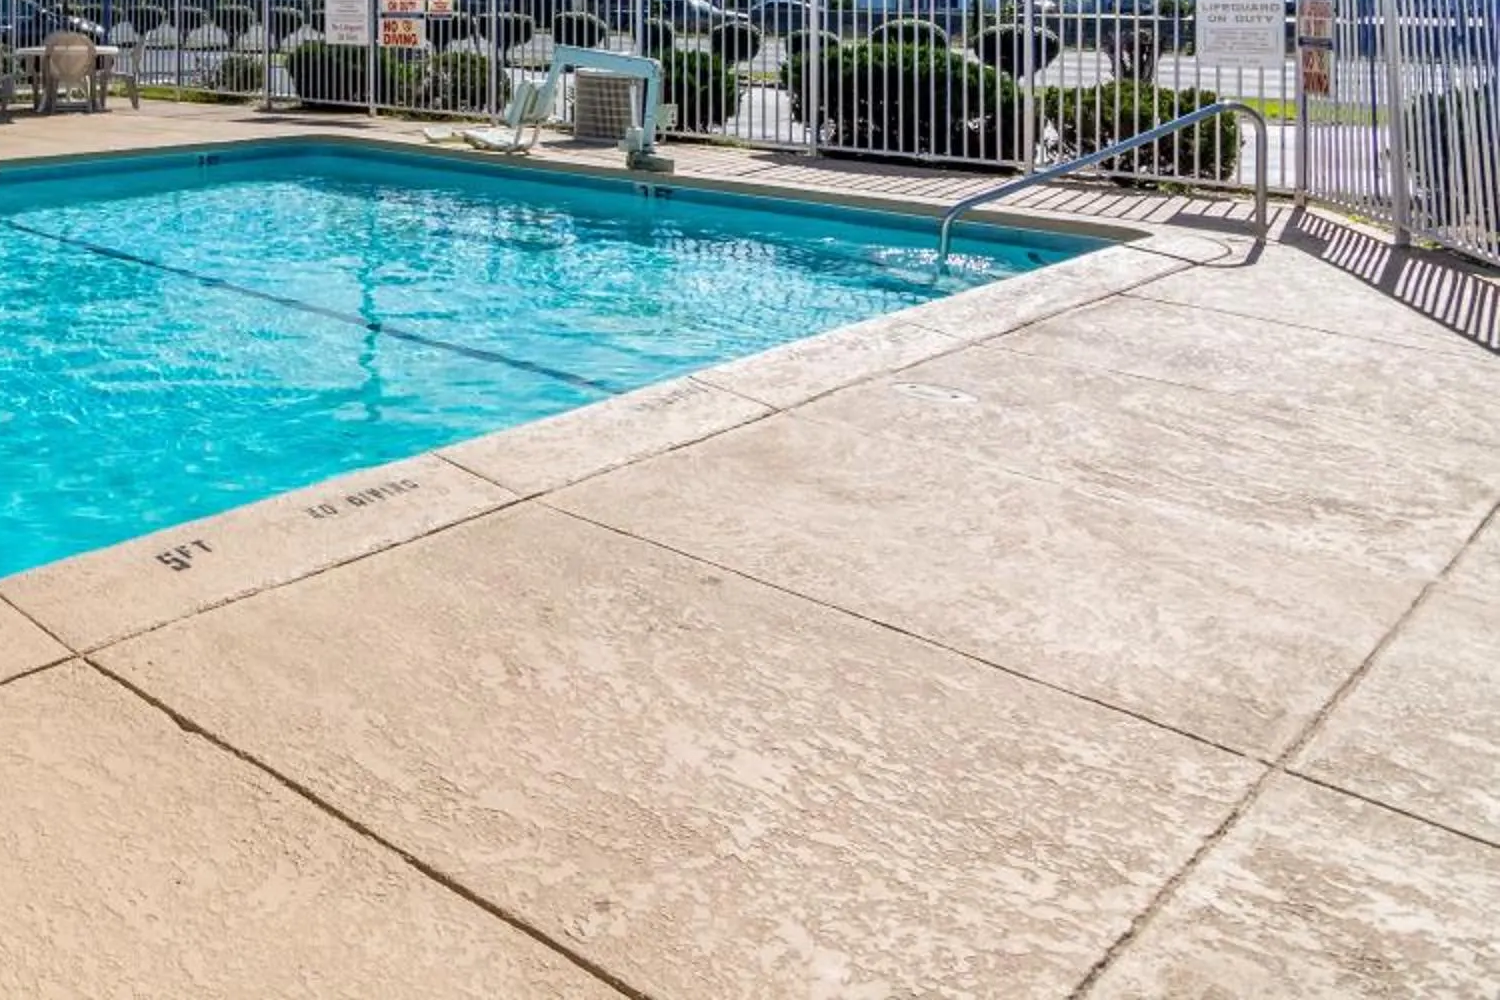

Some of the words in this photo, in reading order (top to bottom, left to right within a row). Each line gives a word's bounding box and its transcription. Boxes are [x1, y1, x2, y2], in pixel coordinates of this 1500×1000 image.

[1201, 2, 1281, 13] LIFEGUARD
[1207, 15, 1227, 24] ON
[1235, 15, 1274, 24] DUTY
[383, 20, 399, 32] NO
[382, 33, 417, 45] DIVING
